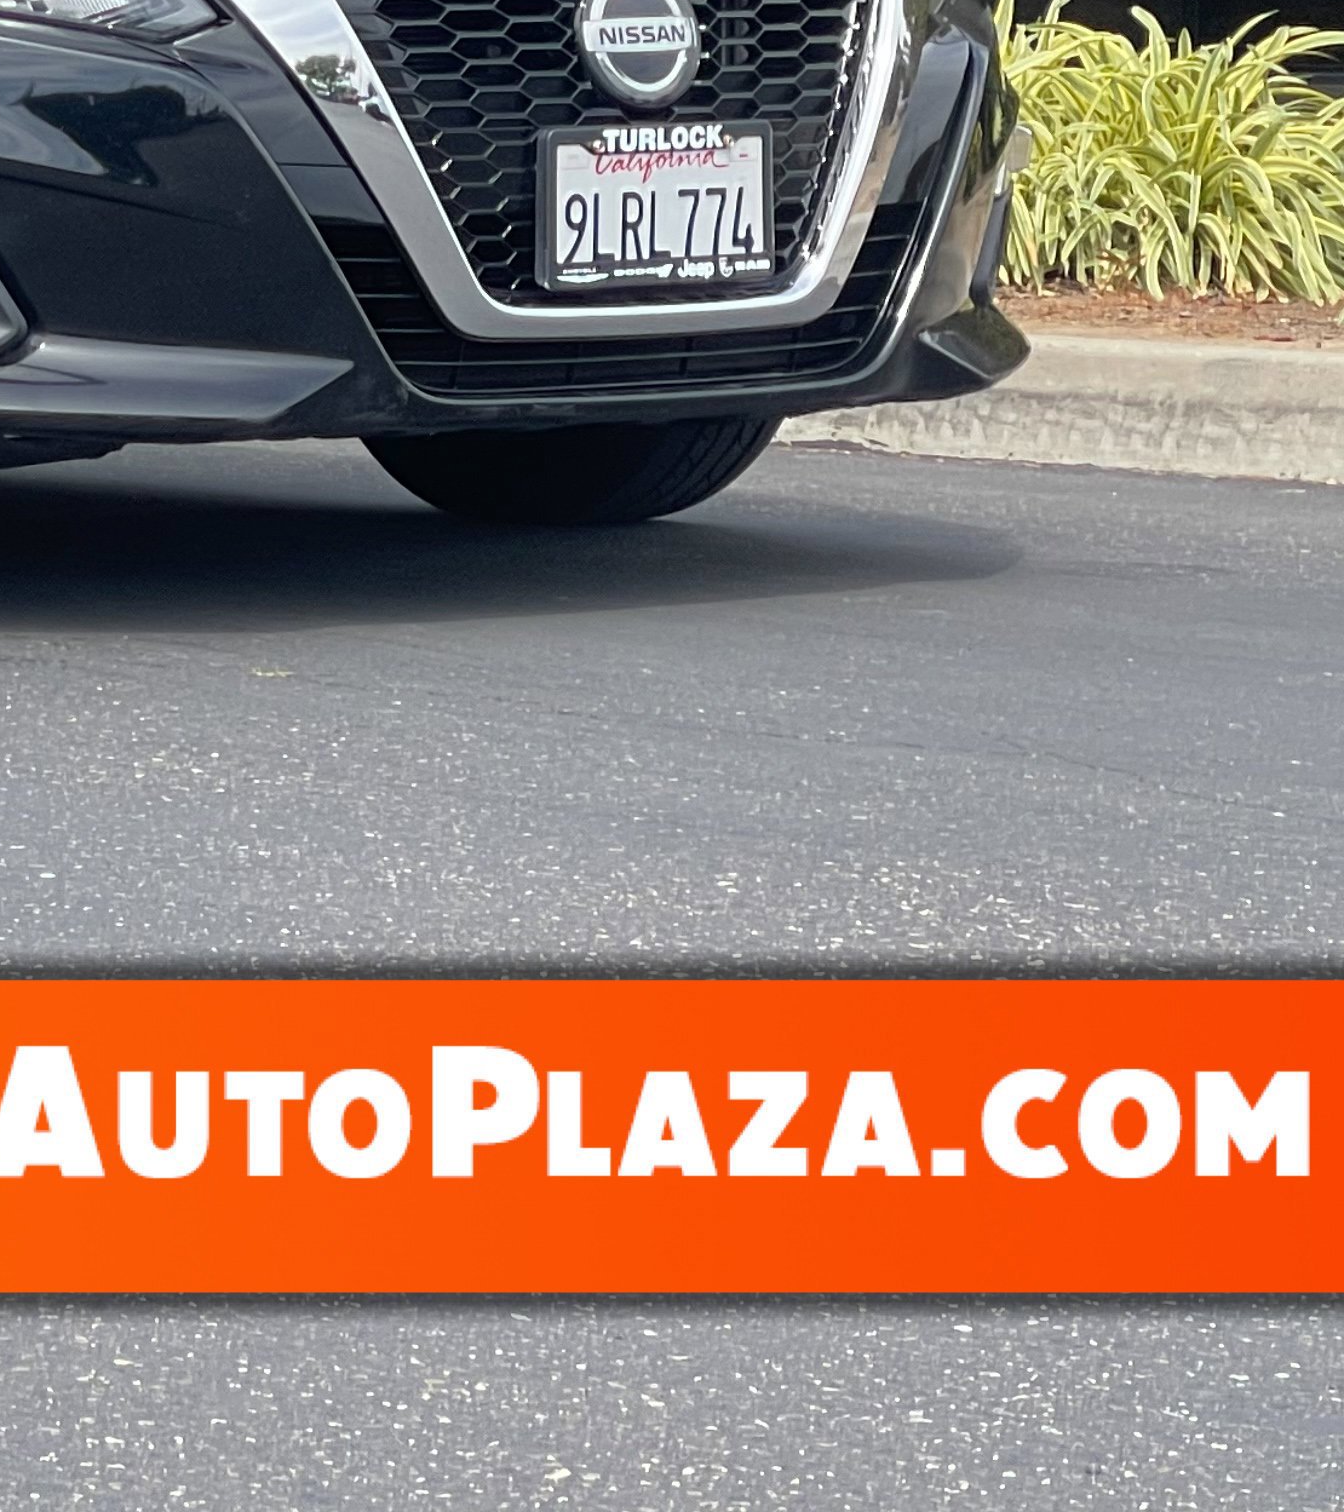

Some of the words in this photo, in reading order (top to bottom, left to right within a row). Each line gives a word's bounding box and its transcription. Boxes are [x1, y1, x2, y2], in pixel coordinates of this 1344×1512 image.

[599, 24, 686, 46] NISSAN
[602, 124, 724, 152] TURLOCK
[595, 150, 730, 184] California
[677, 258, 715, 279] Jeep
